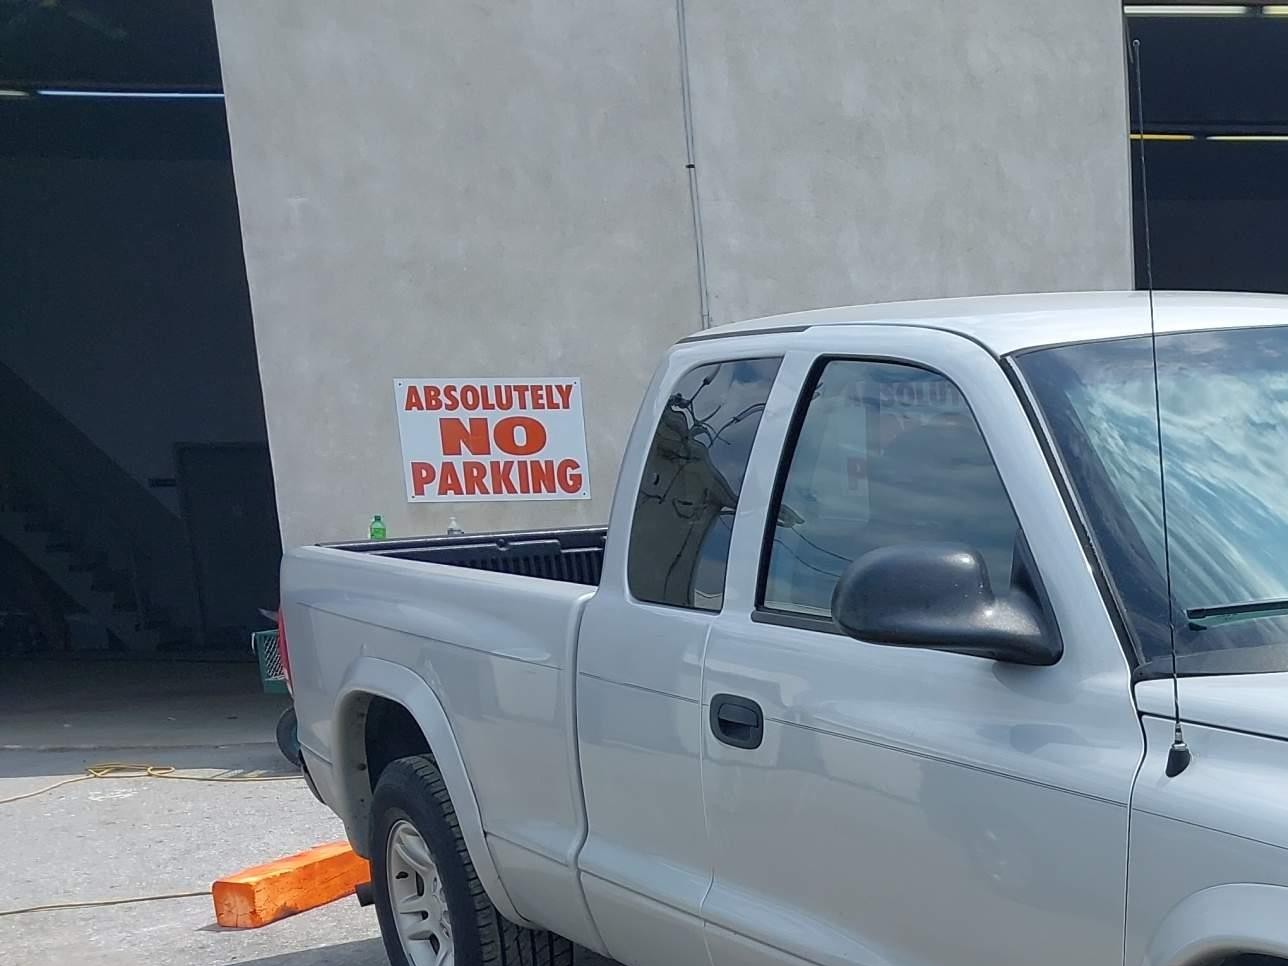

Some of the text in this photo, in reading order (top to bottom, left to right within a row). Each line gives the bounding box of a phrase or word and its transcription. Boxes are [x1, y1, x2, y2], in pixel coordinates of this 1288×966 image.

[405, 385, 573, 411] ABSOLUTELY
[439, 416, 547, 456] NO
[411, 458, 583, 496] PARKING
